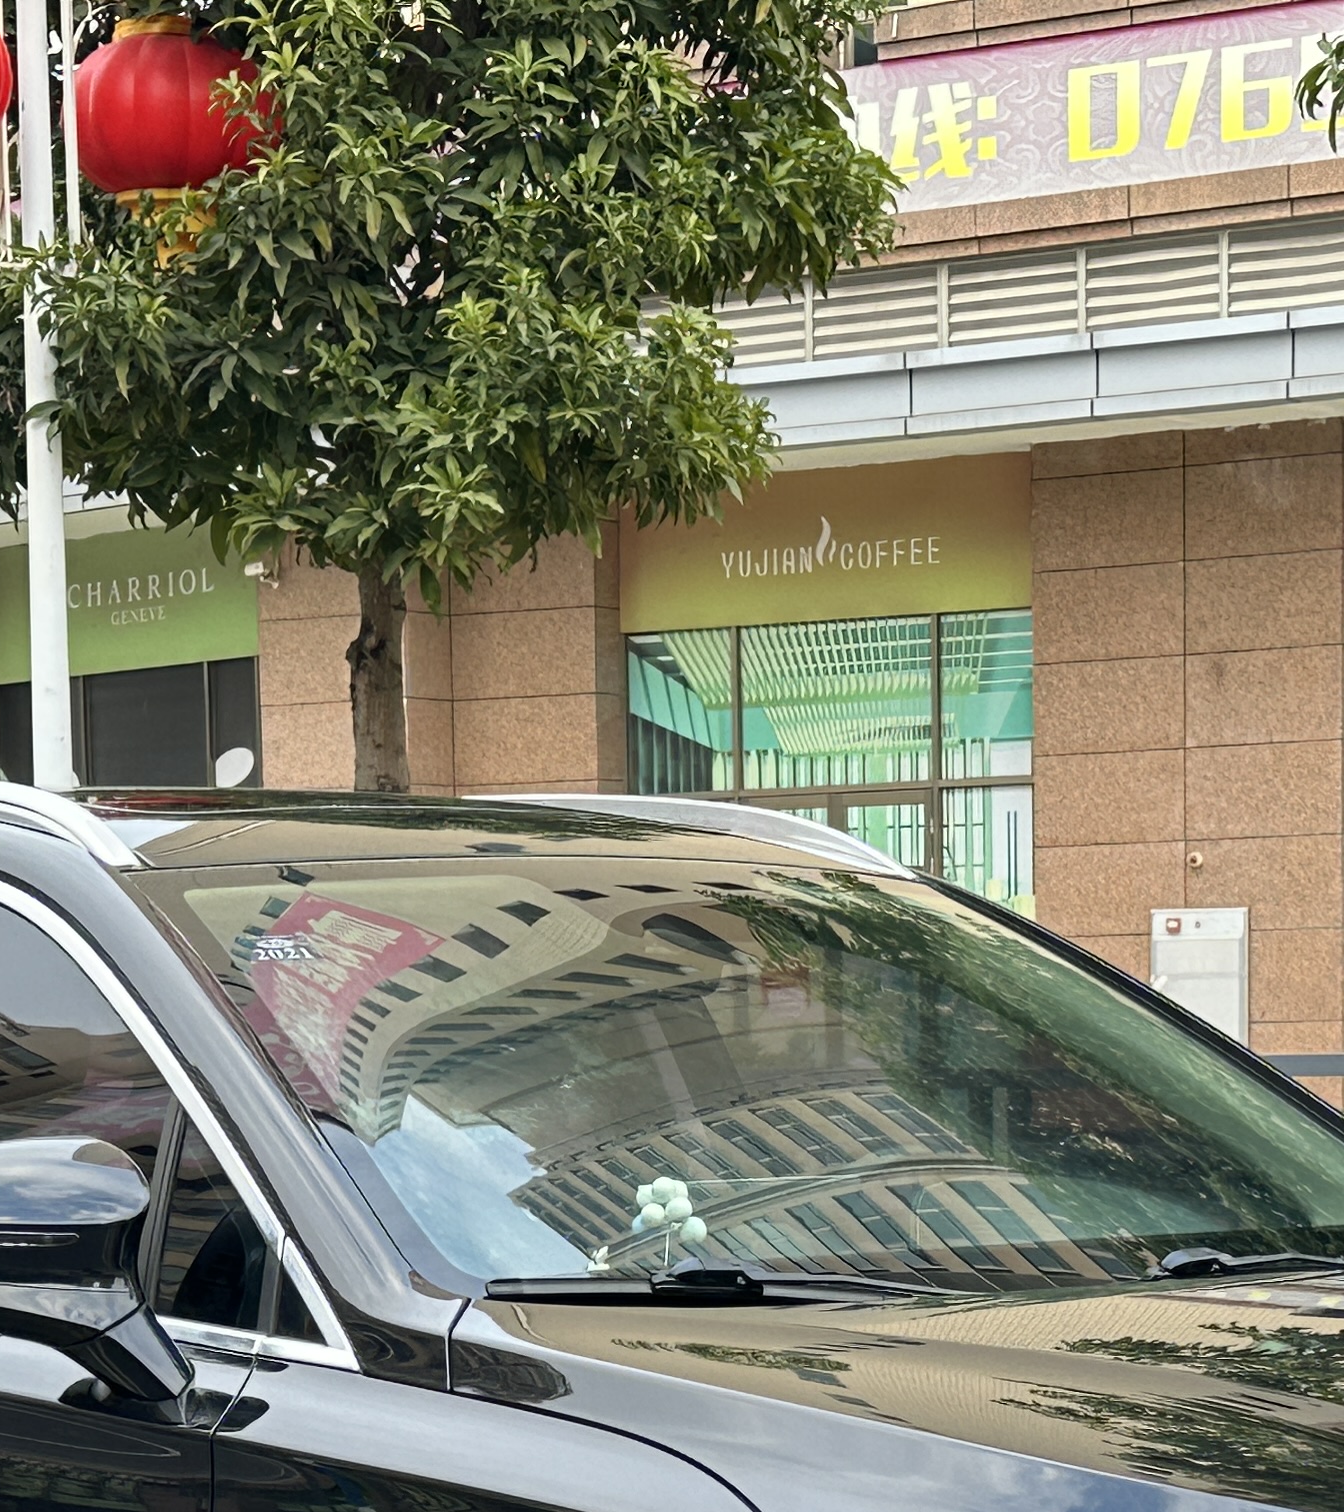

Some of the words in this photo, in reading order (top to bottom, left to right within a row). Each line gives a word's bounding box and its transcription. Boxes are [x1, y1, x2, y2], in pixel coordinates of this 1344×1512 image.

[848, 82, 997, 184] 线:
[721, 546, 813, 579] YUJIAN
[840, 536, 941, 571] COFFEE
[67, 567, 215, 609] CHARRIOL
[253, 947, 315, 961] 2021
